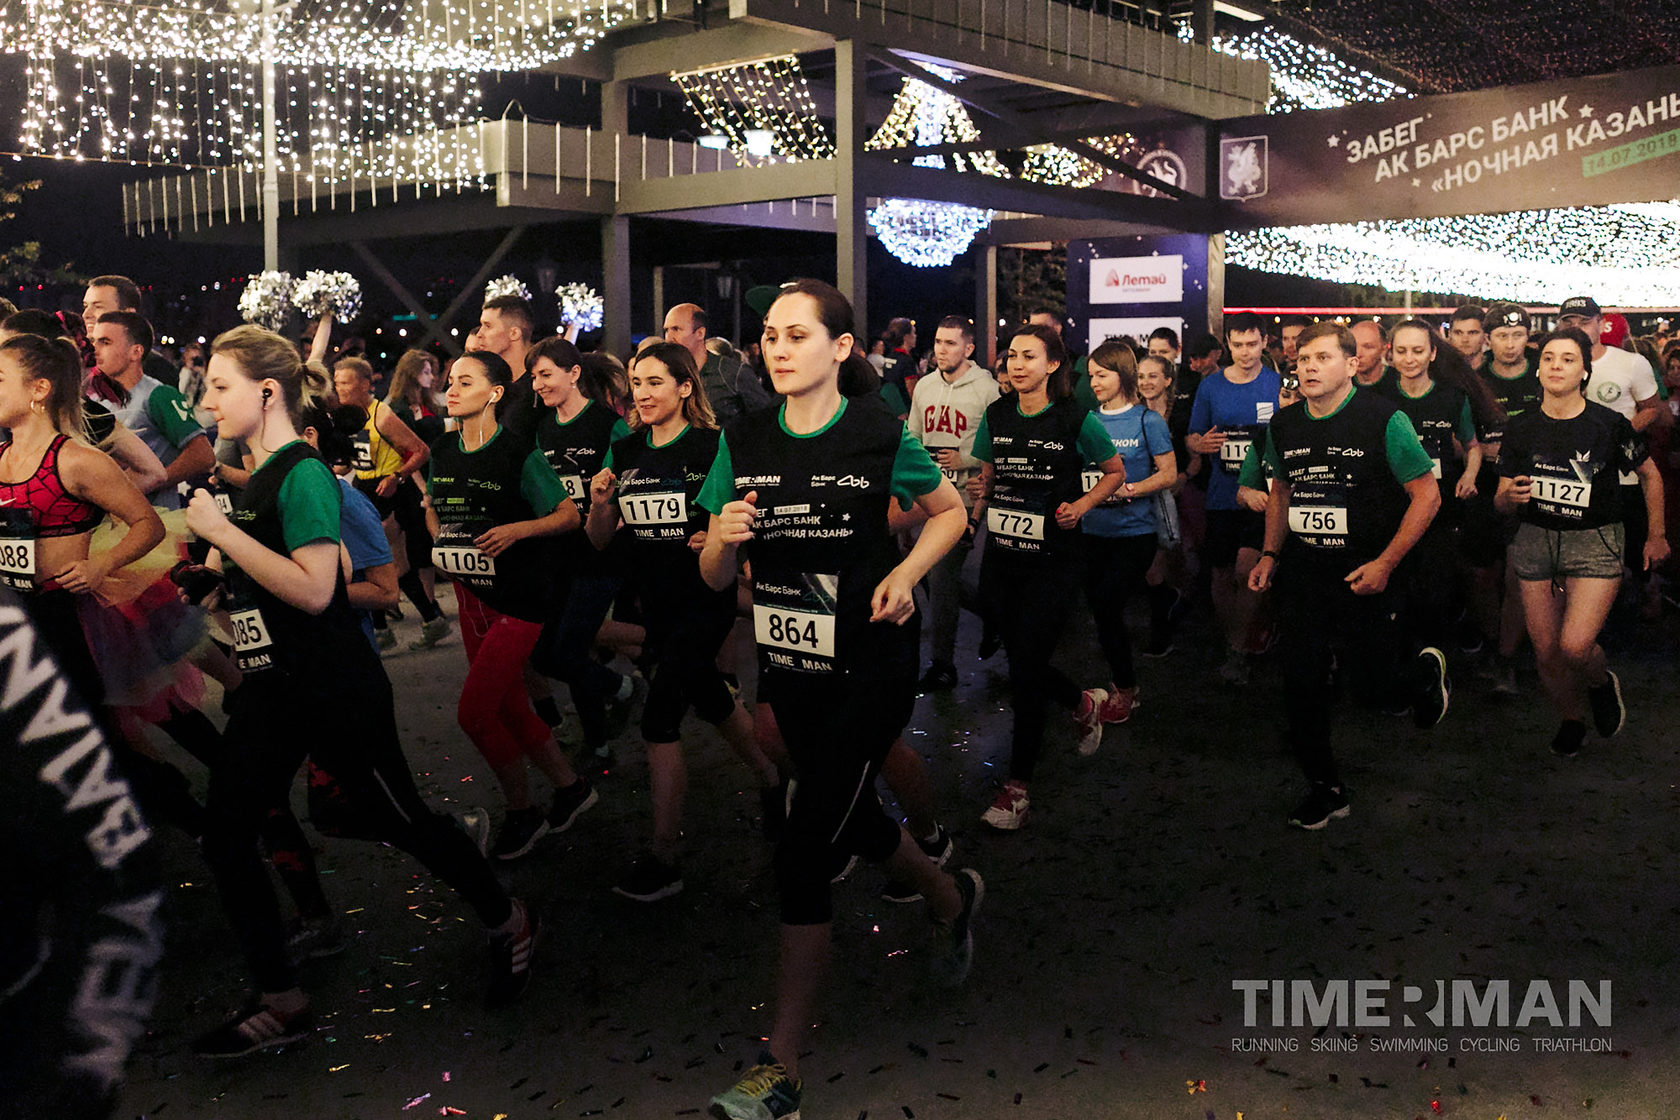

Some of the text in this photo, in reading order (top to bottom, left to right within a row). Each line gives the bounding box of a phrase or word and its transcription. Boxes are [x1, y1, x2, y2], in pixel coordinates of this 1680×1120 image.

[1346, 117, 1423, 163] ЗАБЕГ
[1375, 95, 1569, 183] АК БАРС БАНК
[1432, 133, 1558, 192] «НОЧНАЯ
[1122, 273, 1166, 286] Летай
[924, 405, 967, 439] GAP
[1536, 481, 1585, 502] 1127
[626, 498, 680, 520] 1179
[1561, 507, 1583, 517] MAN
[764, 518, 791, 528] БАРС
[794, 516, 821, 525] БАНК
[997, 513, 1033, 536] 772
[1299, 511, 1336, 530] 756
[634, 528, 685, 537] TIME MAN
[1018, 541, 1040, 550] MAN
[438, 552, 490, 572] 1105
[756, 582, 801, 596] Ак Барс Банк
[768, 614, 819, 648] 864
[768, 652, 794, 666] TIME
[801, 659, 833, 671] MAN
